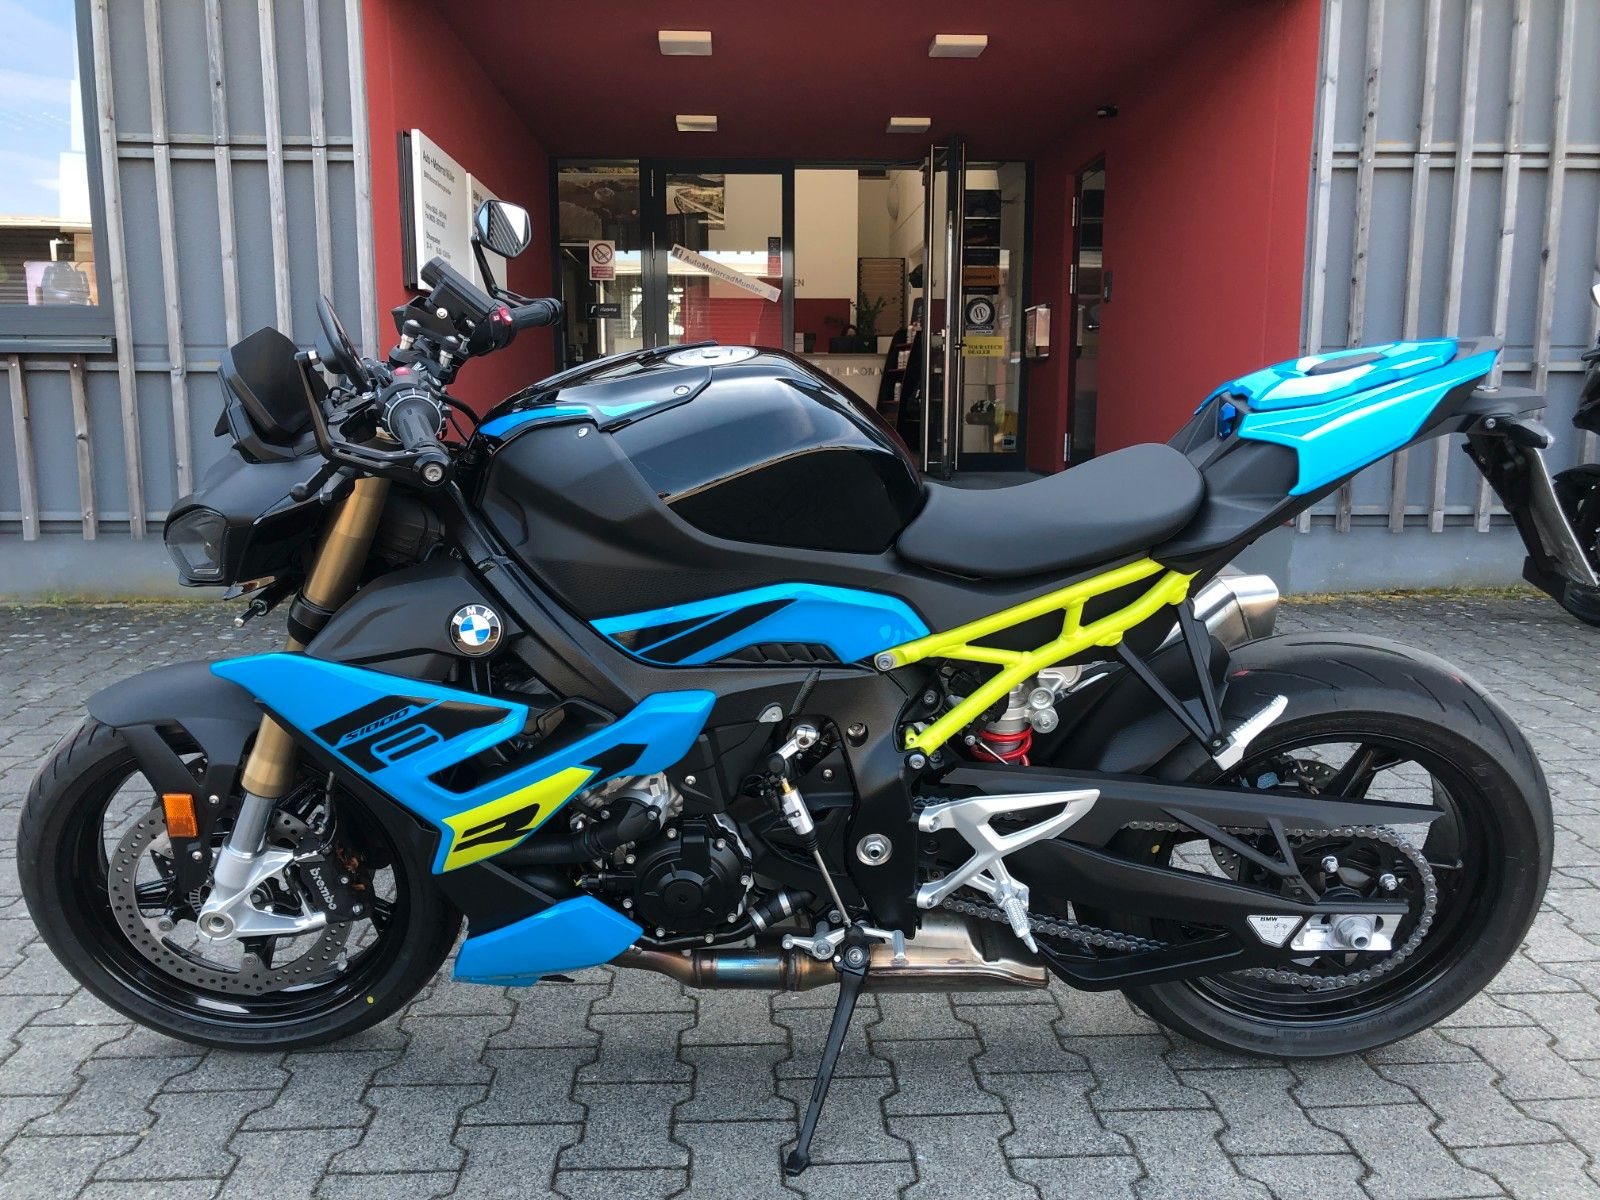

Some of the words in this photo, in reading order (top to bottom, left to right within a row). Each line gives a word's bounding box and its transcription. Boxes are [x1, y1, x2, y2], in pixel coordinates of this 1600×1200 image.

[683, 254, 763, 294] AutoMotorradMueller
[452, 606, 495, 626] BMW
[344, 706, 412, 741] S1000
[309, 867, 337, 911] brembo
